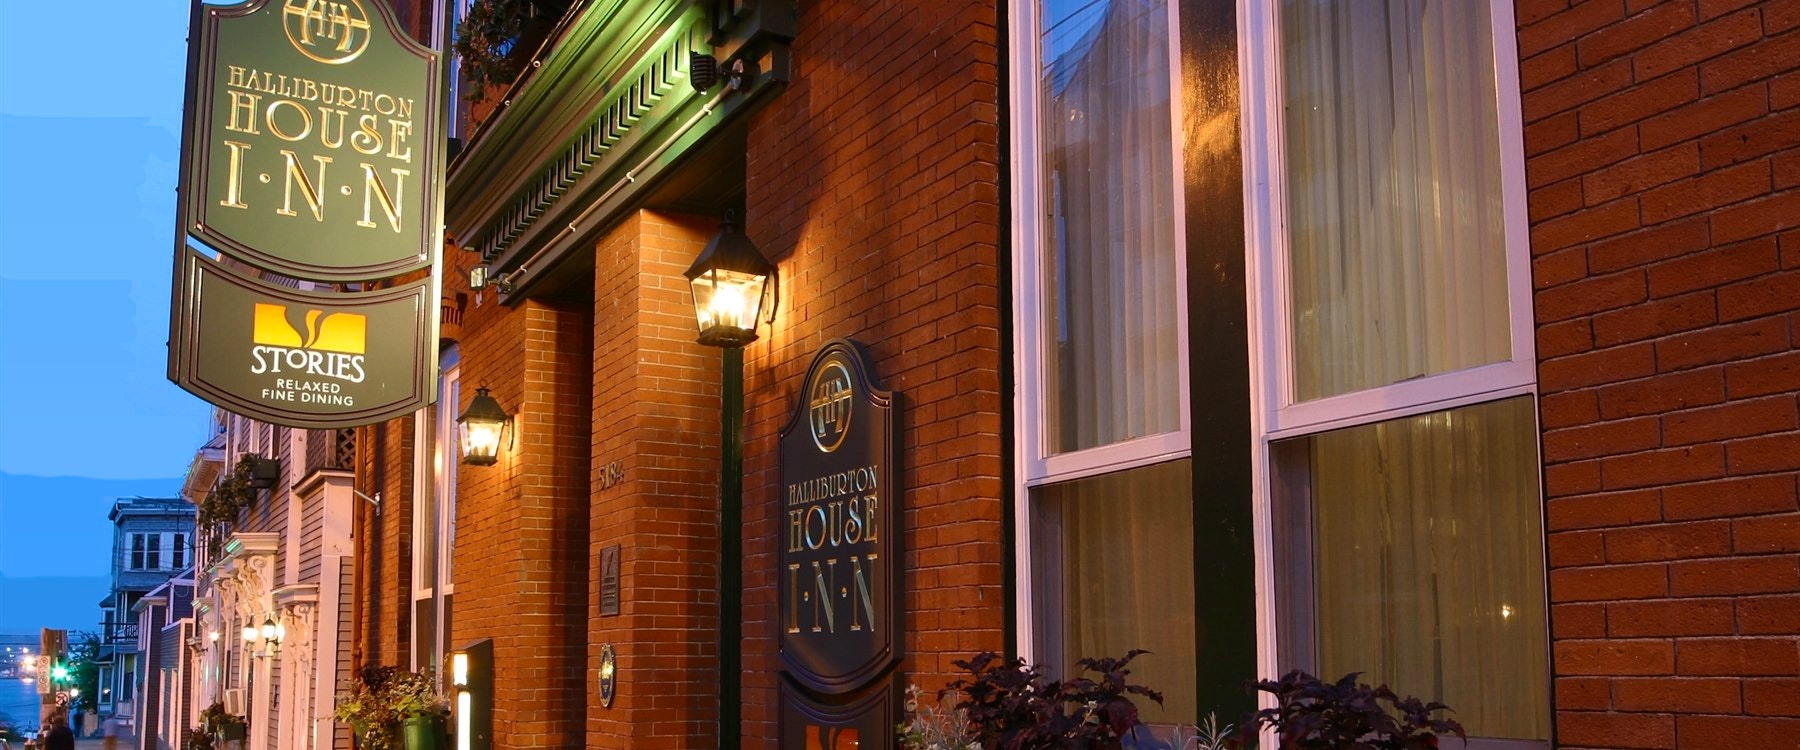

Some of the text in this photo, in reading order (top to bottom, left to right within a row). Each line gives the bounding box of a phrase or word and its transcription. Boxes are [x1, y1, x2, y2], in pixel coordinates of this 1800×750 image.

[227, 65, 413, 119] HALLIBURTON
[225, 90, 412, 163] HOUSE
[251, 345, 365, 383] STORIES
[262, 389, 353, 406] FINE DINING
[276, 378, 341, 394] RELAXED
[598, 461, 624, 490] 5184
[788, 465, 877, 506] HALLIBURTON
[788, 492, 878, 552] HOUSE
